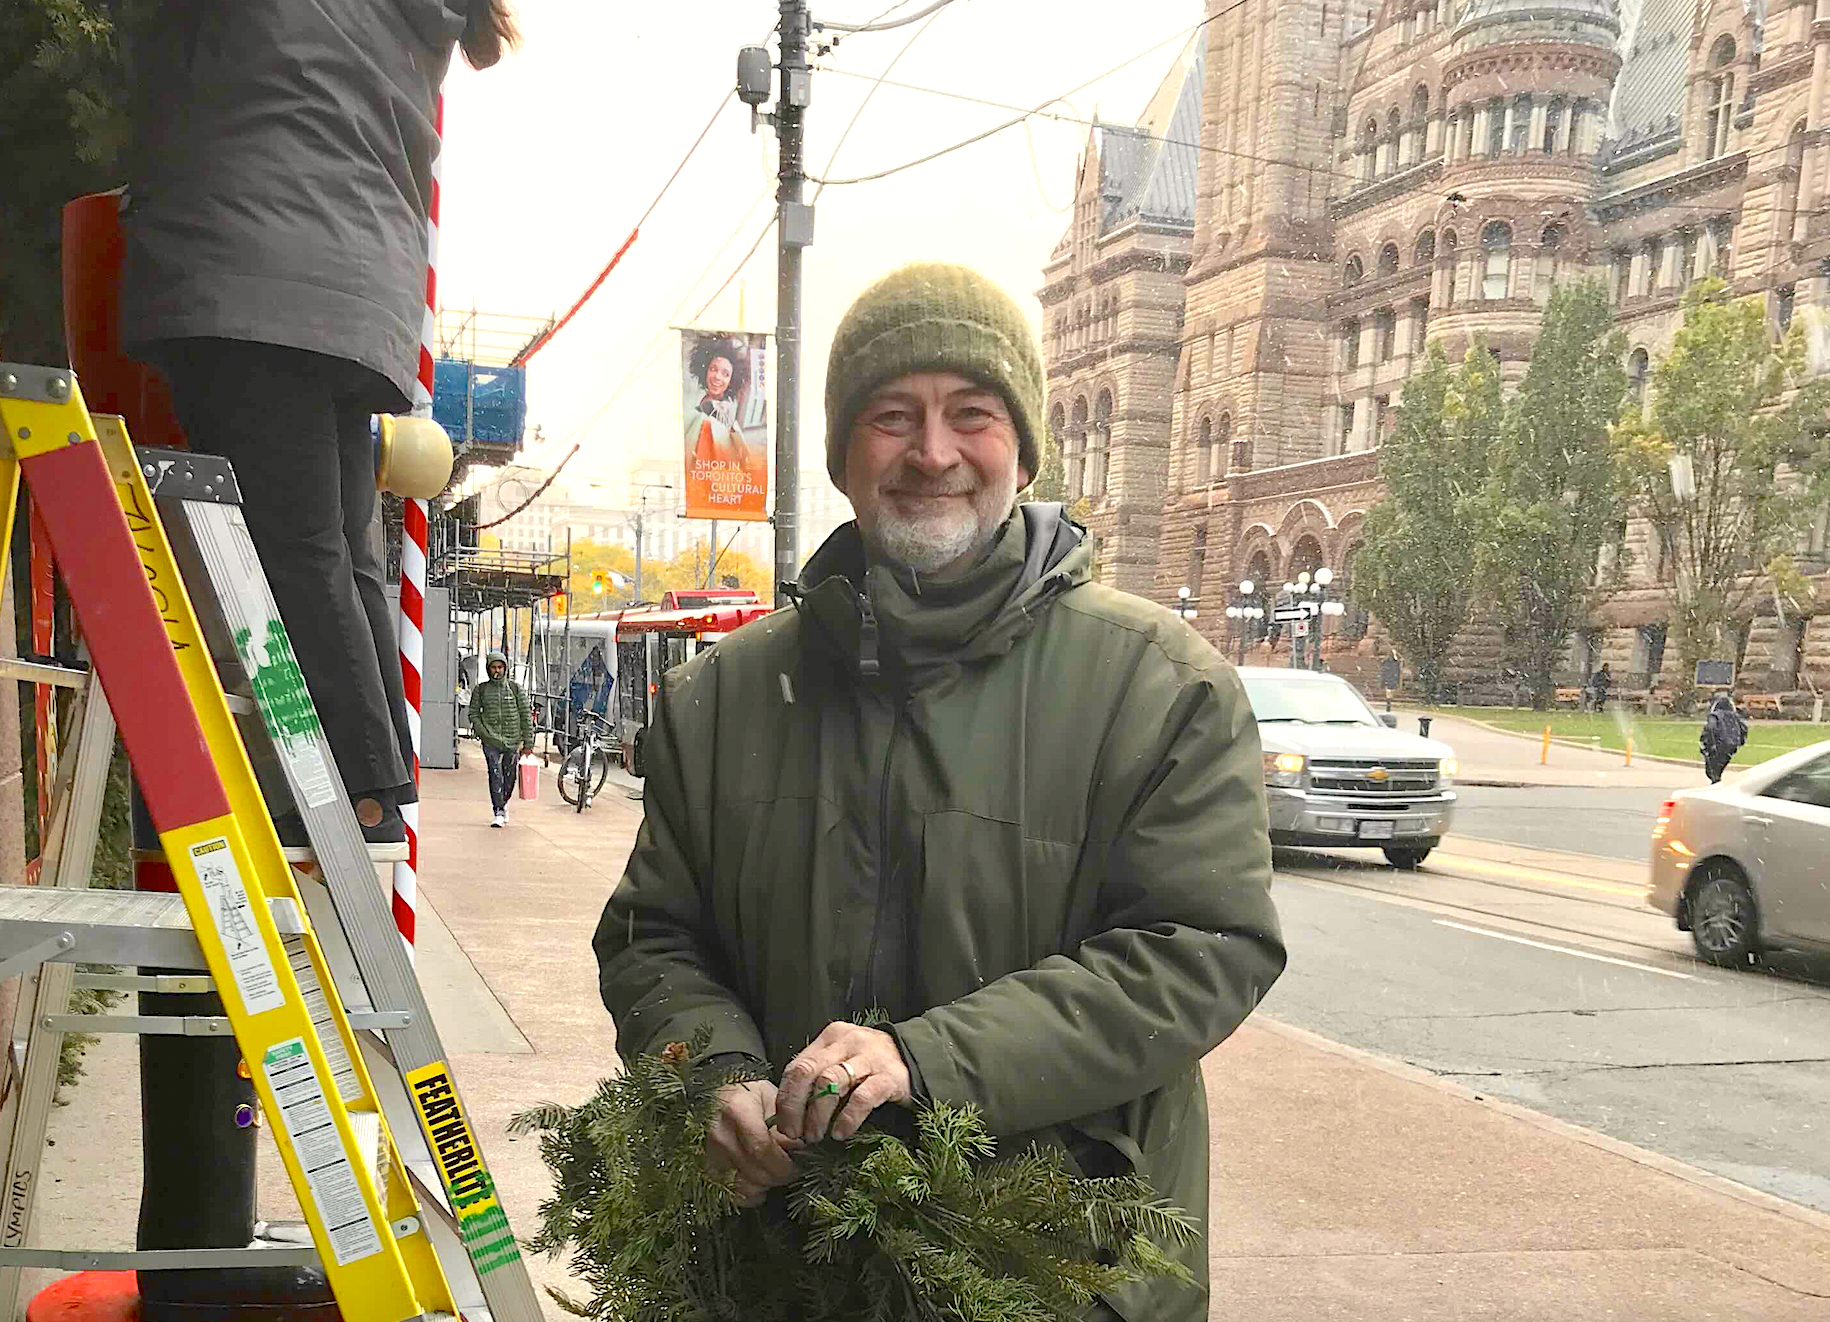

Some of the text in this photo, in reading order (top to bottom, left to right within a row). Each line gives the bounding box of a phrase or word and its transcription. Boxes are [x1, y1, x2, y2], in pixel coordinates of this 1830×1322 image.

[695, 459, 741, 471] SHOP IN
[690, 470, 752, 484] TORONTO'S
[711, 482, 765, 495] CULTURAL
[708, 493, 743, 505] HEART
[414, 1073, 491, 1210] FEATHERLITE
